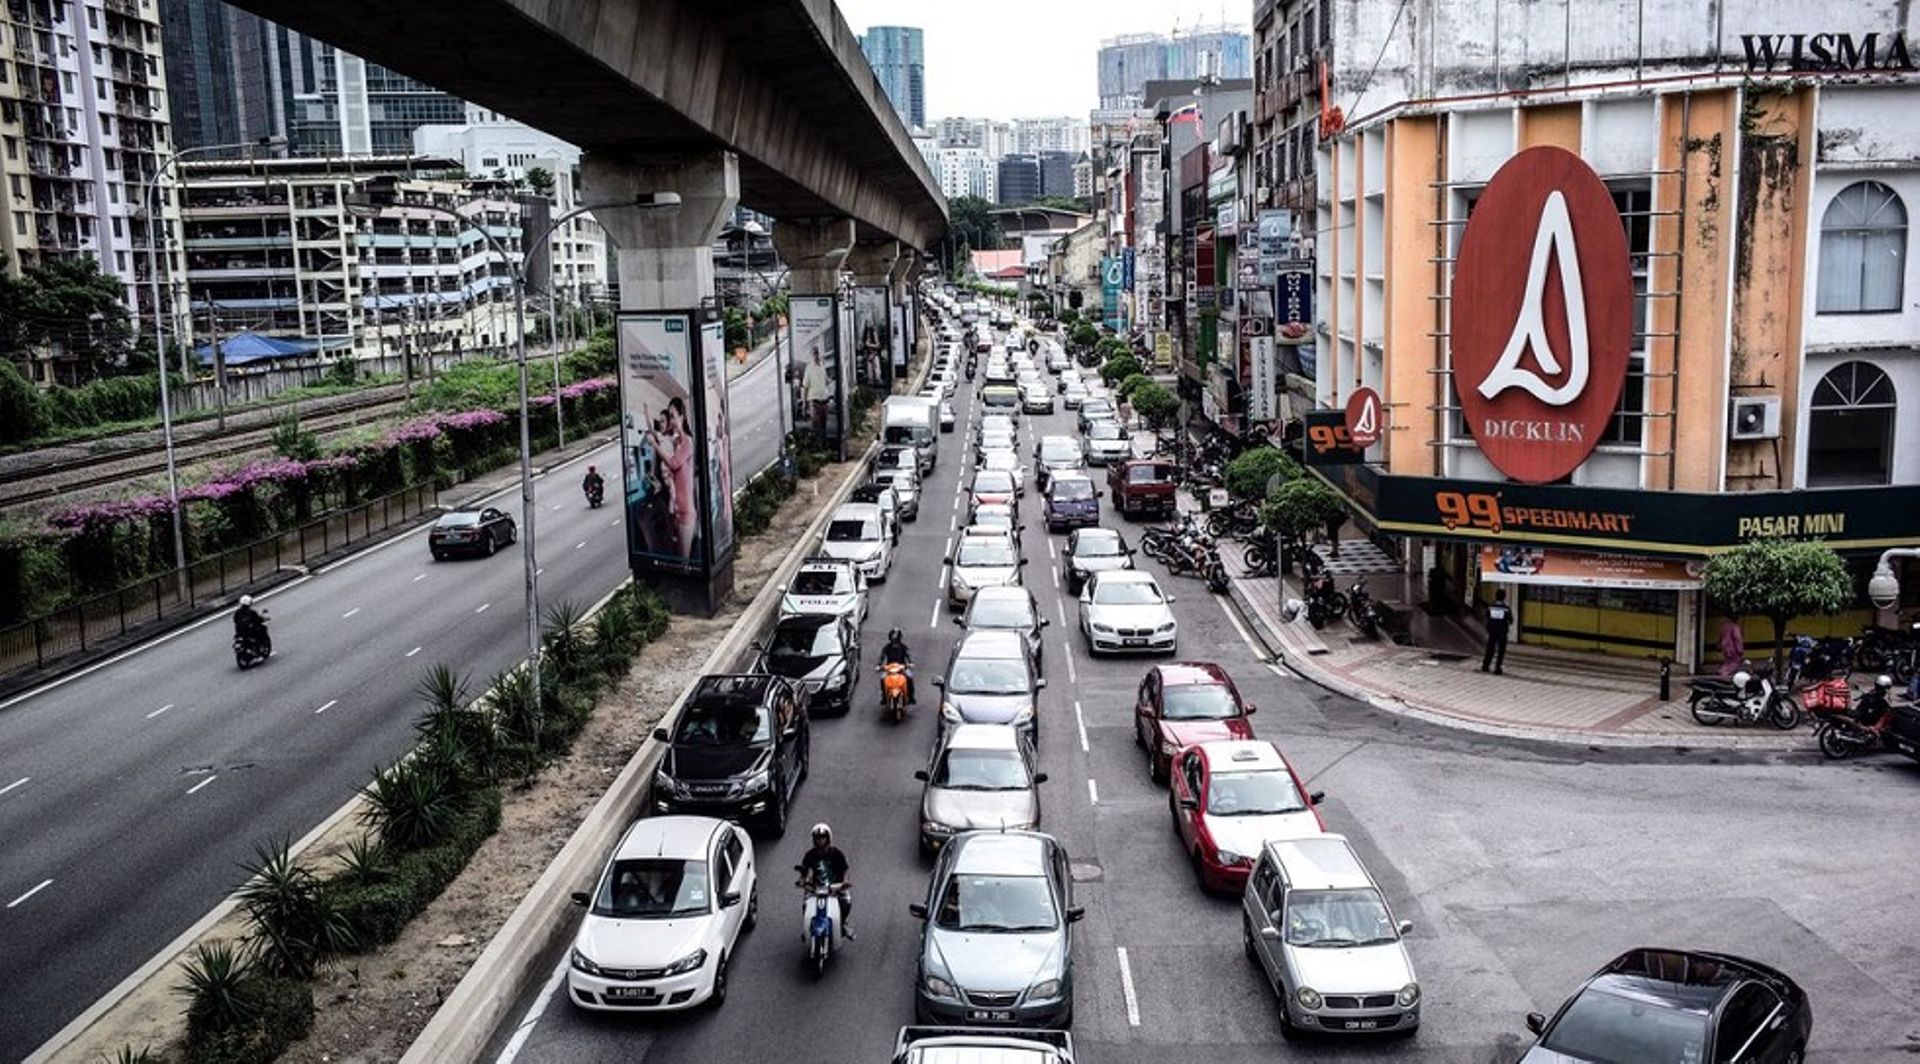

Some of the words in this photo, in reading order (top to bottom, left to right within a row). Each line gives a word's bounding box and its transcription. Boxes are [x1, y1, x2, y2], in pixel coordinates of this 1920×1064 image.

[1740, 32, 1919, 73] WISMA
[1485, 419, 1585, 441] DICKLIN
[1435, 491, 1502, 533] 99
[1502, 506, 1634, 533] SPEEDMART
[1738, 516, 1799, 537] PASAR
[1803, 513, 1845, 533] MINI
